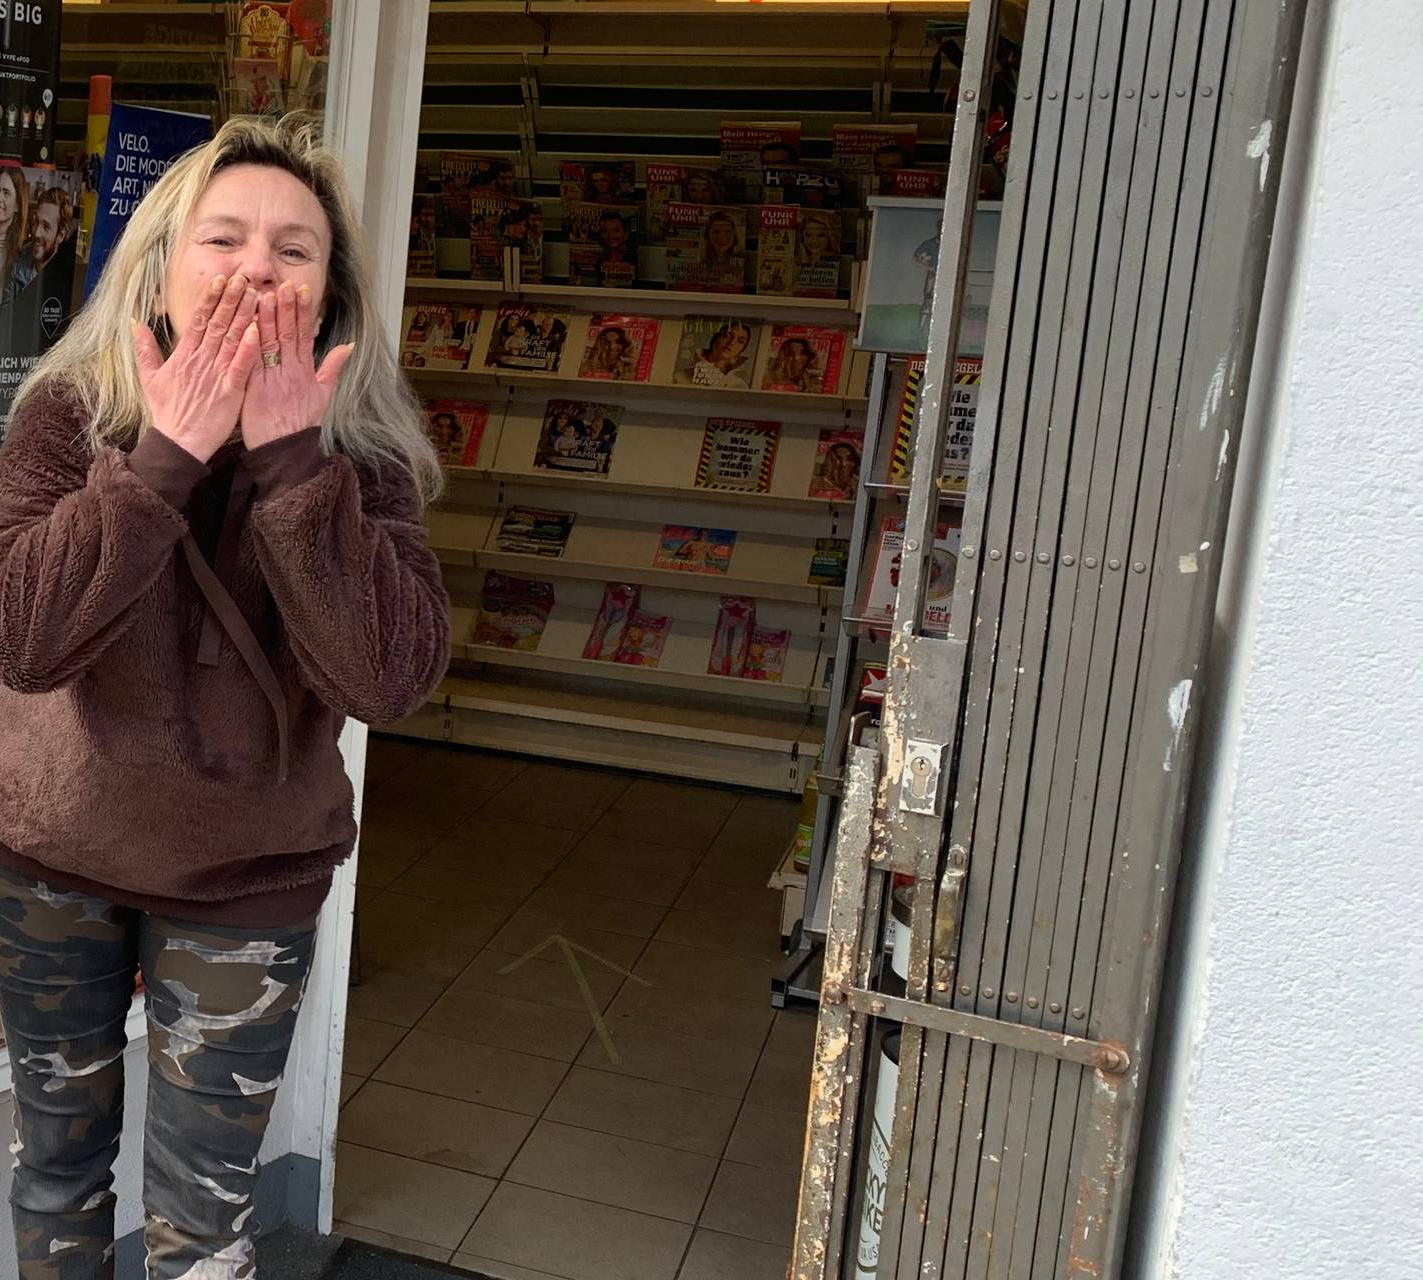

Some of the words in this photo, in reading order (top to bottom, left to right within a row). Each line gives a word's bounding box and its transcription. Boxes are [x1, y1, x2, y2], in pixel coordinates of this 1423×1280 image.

[14, 2, 42, 25] BIG
[2, 54, 16, 62] VYPE
[118, 131, 151, 154] VELO.
[115, 154, 137, 173] DIE
[647, 167, 679, 176] FUNK
[896, 174, 930, 183] FUNK
[112, 176, 140, 198] ART,
[108, 198, 129, 216] ZU
[668, 206, 699, 215] FUNK
[761, 210, 793, 219] FUNK
[764, 217, 790, 225] UHR
[911, 360, 925, 371] DE
[952, 391, 971, 404] ie
[730, 437, 750, 446] Wie
